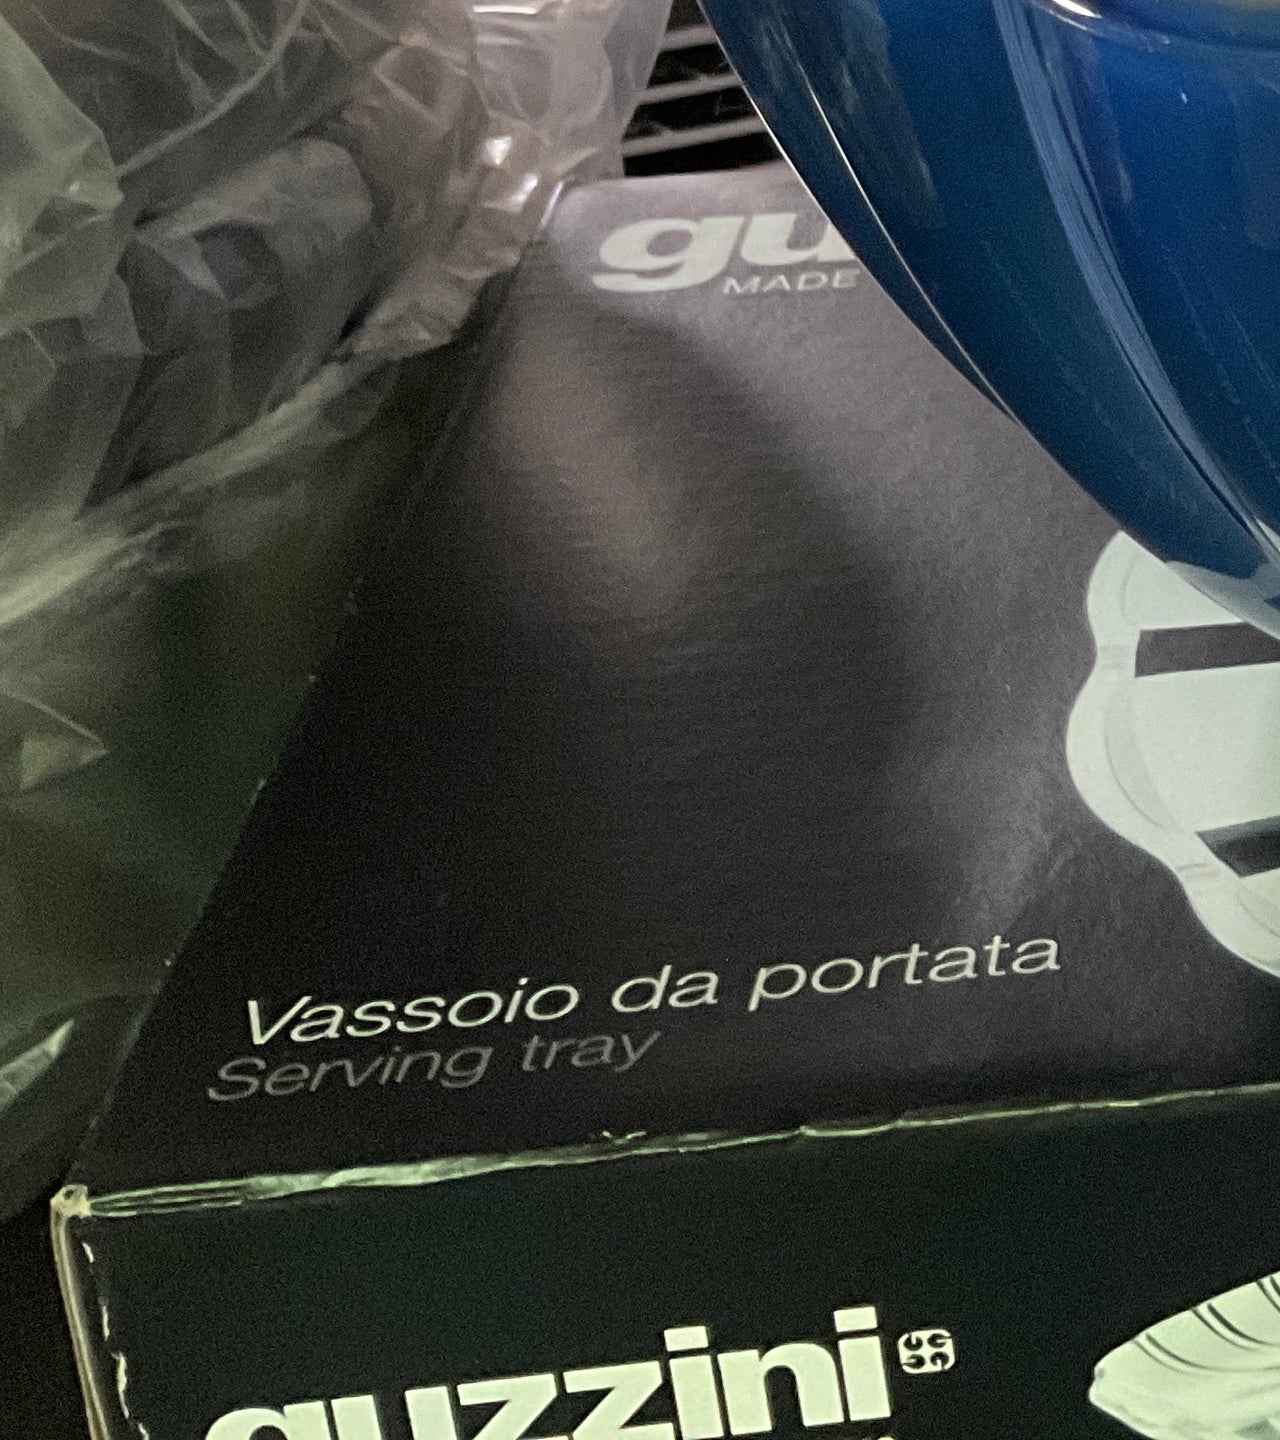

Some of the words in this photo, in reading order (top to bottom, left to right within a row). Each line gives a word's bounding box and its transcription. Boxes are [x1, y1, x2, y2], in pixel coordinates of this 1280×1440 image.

[722, 268, 861, 295] MADE
[246, 976, 578, 1046] Vassoio
[609, 964, 719, 1013] da
[746, 931, 1062, 1012] portata
[206, 1042, 493, 1104] Serving
[519, 1026, 663, 1075] tray
